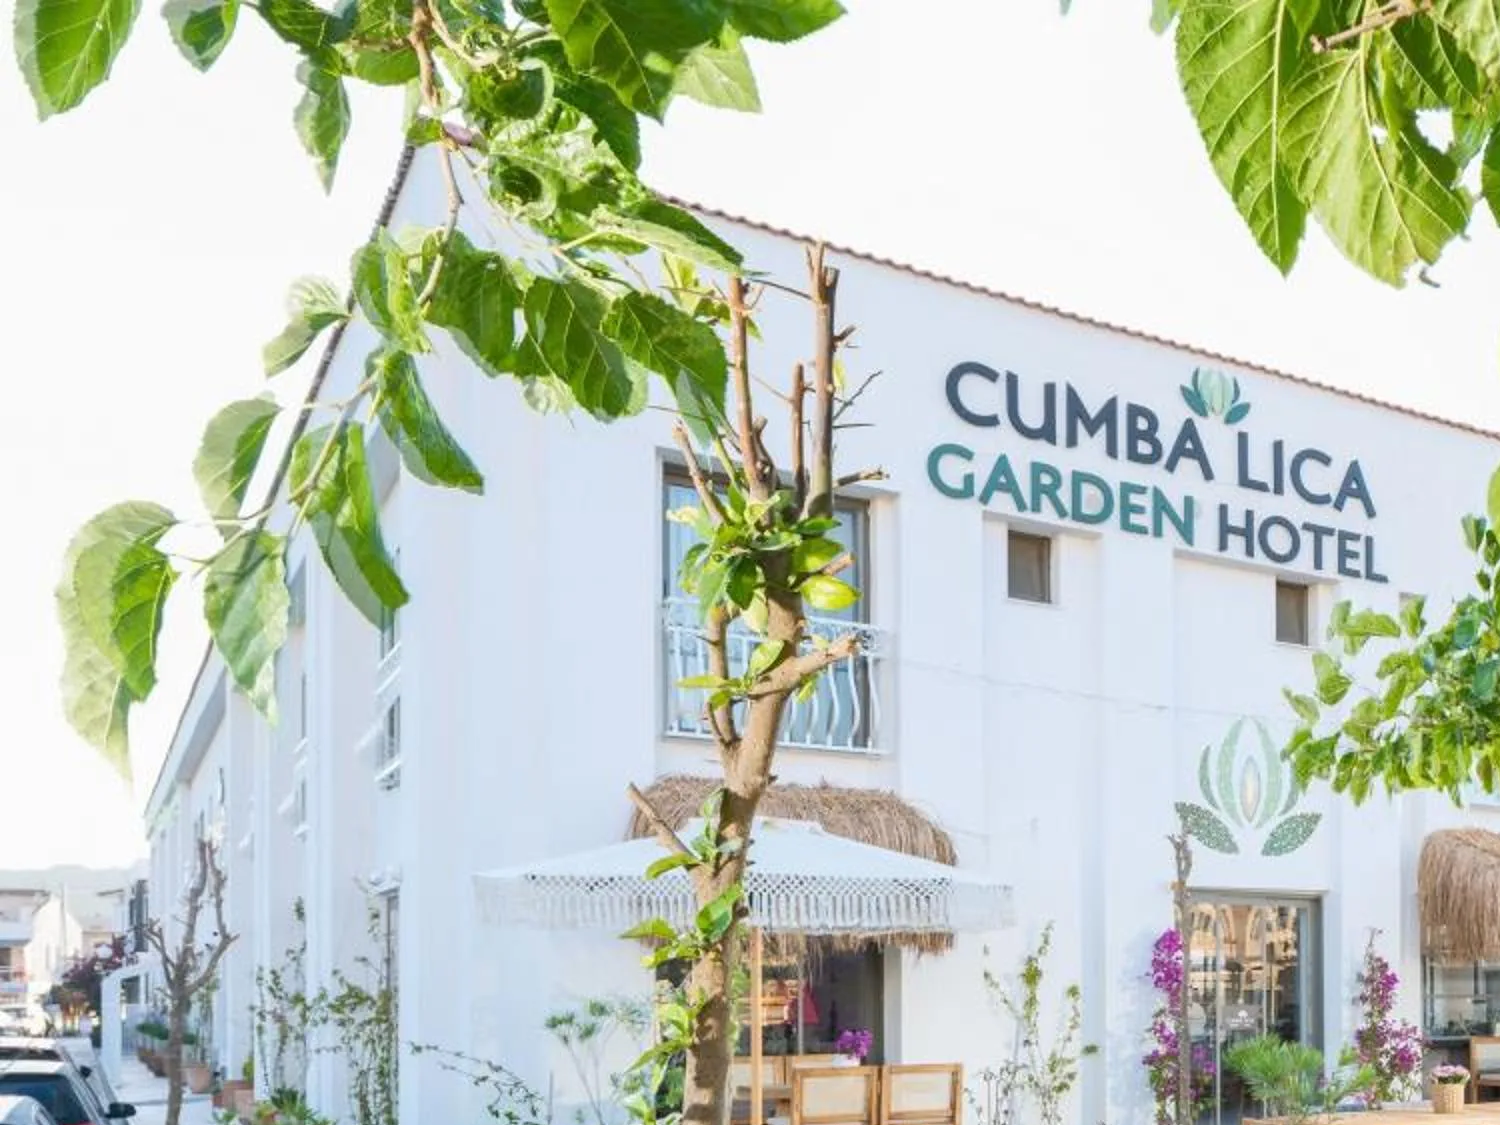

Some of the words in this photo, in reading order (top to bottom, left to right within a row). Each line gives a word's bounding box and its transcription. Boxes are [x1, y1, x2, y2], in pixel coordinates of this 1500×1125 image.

[925, 442, 1196, 548] GARDEN
[1217, 502, 1390, 585] HOTEL
[944, 360, 1216, 483] CUMBA
[1236, 430, 1377, 520] LICA
